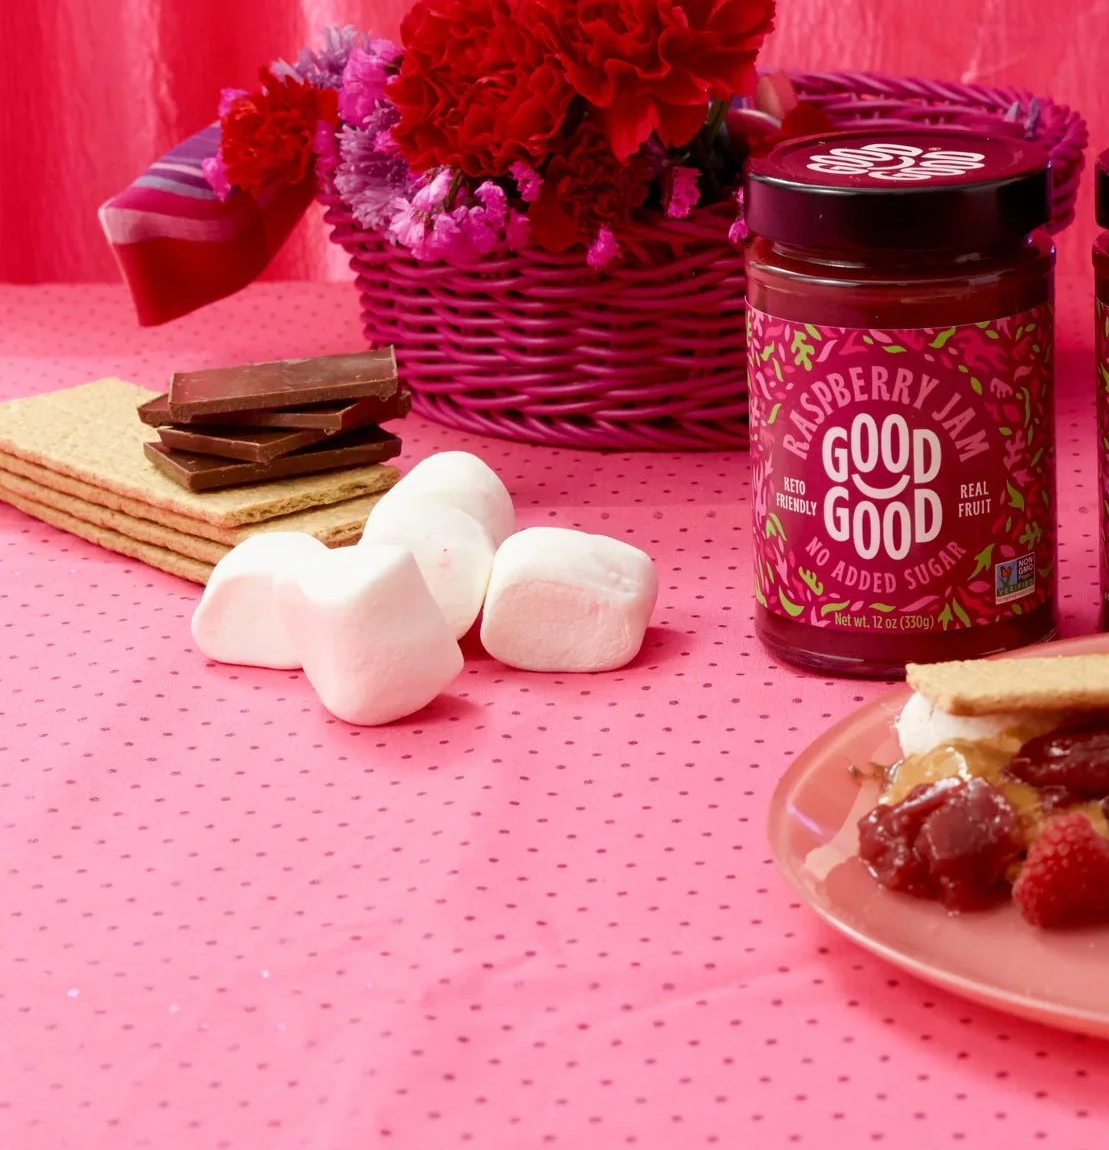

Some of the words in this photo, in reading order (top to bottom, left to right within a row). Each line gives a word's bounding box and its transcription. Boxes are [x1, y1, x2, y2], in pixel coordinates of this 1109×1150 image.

[782, 365, 940, 461] RASPBERRY
[931, 392, 990, 462] JAM
[822, 413, 942, 484] GOOD
[784, 476, 806, 495] KETO
[960, 481, 989, 499] REAL
[776, 492, 817, 517] FRIENDLY
[958, 499, 991, 518] FRUIT
[824, 486, 943, 560] GOOD
[805, 536, 830, 567] NO
[831, 560, 897, 594] ADDED
[904, 541, 967, 590] SUGAR
[1018, 556, 1033, 567] NON
[1018, 563, 1034, 575] GMO
[834, 612, 852, 626] Net
[854, 614, 870, 628] wt.
[873, 616, 883, 628] 12
[885, 618, 897, 629] oz
[900, 614, 934, 630] (330g)
